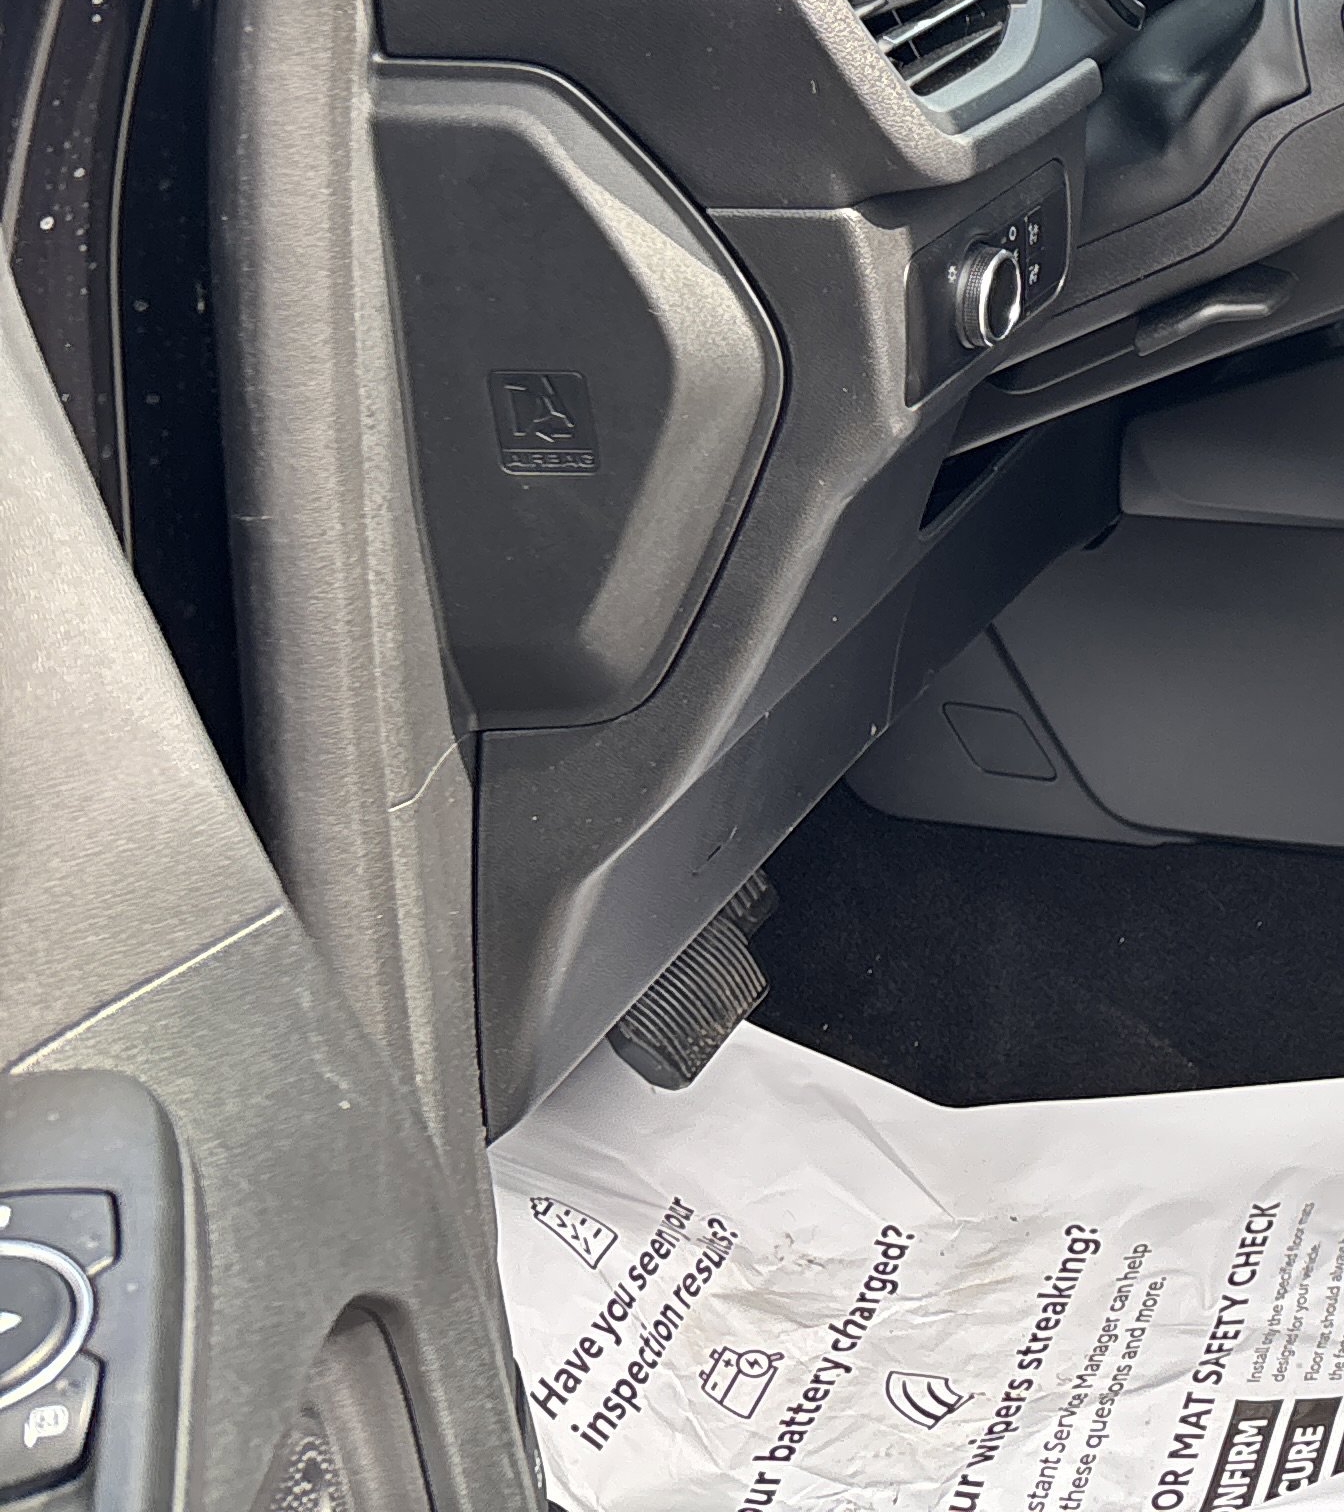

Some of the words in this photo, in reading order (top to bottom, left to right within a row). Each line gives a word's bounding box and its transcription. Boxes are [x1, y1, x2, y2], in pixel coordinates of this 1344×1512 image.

[529, 1335, 604, 1421] Have
[591, 1282, 637, 1347] you
[628, 1228, 680, 1291] seen
[660, 1196, 695, 1242] your
[1109, 1278, 1134, 1313] can
[1117, 1243, 1153, 1281] help
[1296, 1281, 1310, 1312] your
[571, 1304, 684, 1451] inspection
[673, 1217, 738, 1310] results?
[752, 1357, 852, 1462] battery
[828, 1225, 915, 1352] charged?
[966, 1378, 1034, 1468] wipers
[1016, 1224, 1101, 1370] streaking?
[1072, 1316, 1128, 1389] Manager
[1167, 1391, 1215, 1459] MAT
[1192, 1294, 1249, 1385] SAFETY
[1227, 1202, 1281, 1287] CHECK
[1246, 1347, 1270, 1383] Install
[1266, 1304, 1284, 1327] the
[1303, 1350, 1325, 1382] Floor
[1320, 1285, 1341, 1329] should
[1043, 1386, 1089, 1454] Service
[1058, 1453, 1097, 1511] these
[1121, 1327, 1147, 1360] and
[1134, 1276, 1167, 1323] more.
